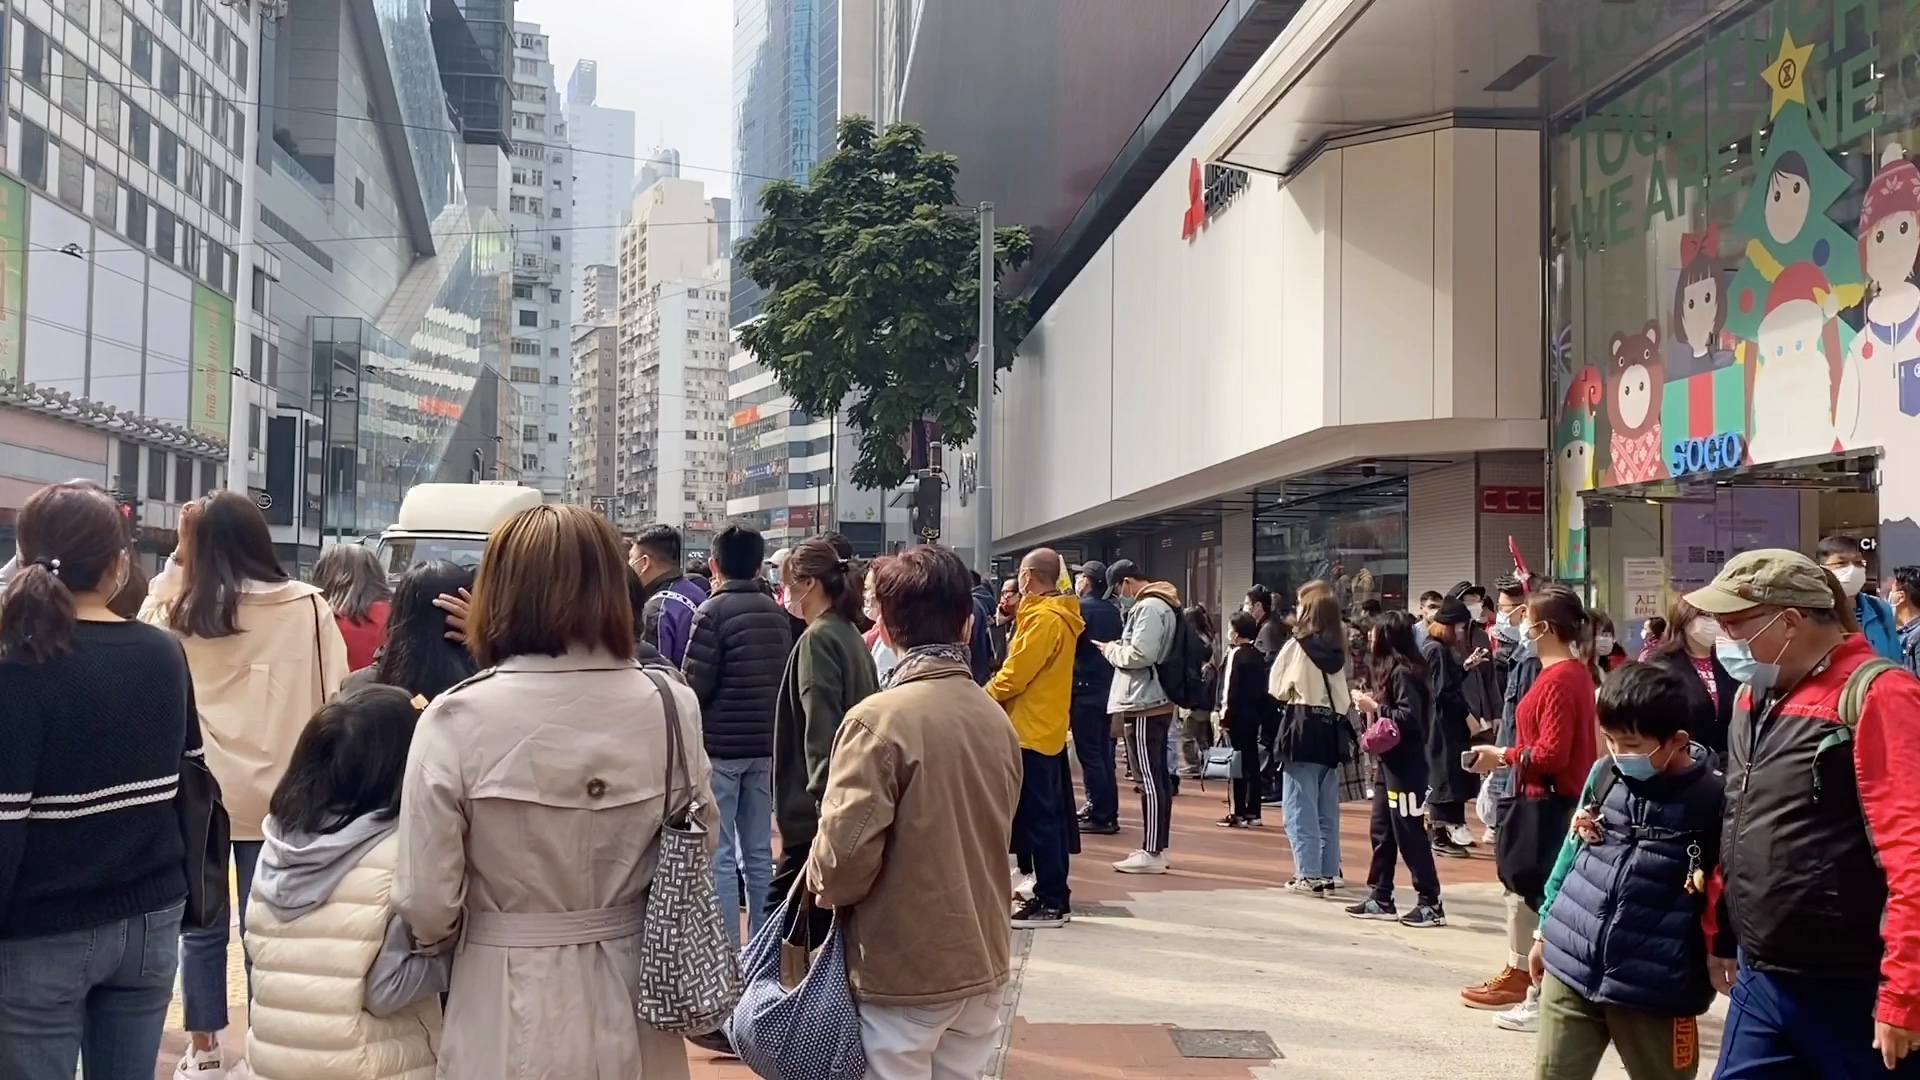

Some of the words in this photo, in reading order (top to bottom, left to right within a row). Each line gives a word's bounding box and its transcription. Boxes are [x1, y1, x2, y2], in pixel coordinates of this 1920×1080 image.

[1570, 174, 1634, 262] WE
[1671, 431, 1742, 478] SOGO
[1636, 594, 1656, 605] 入口
